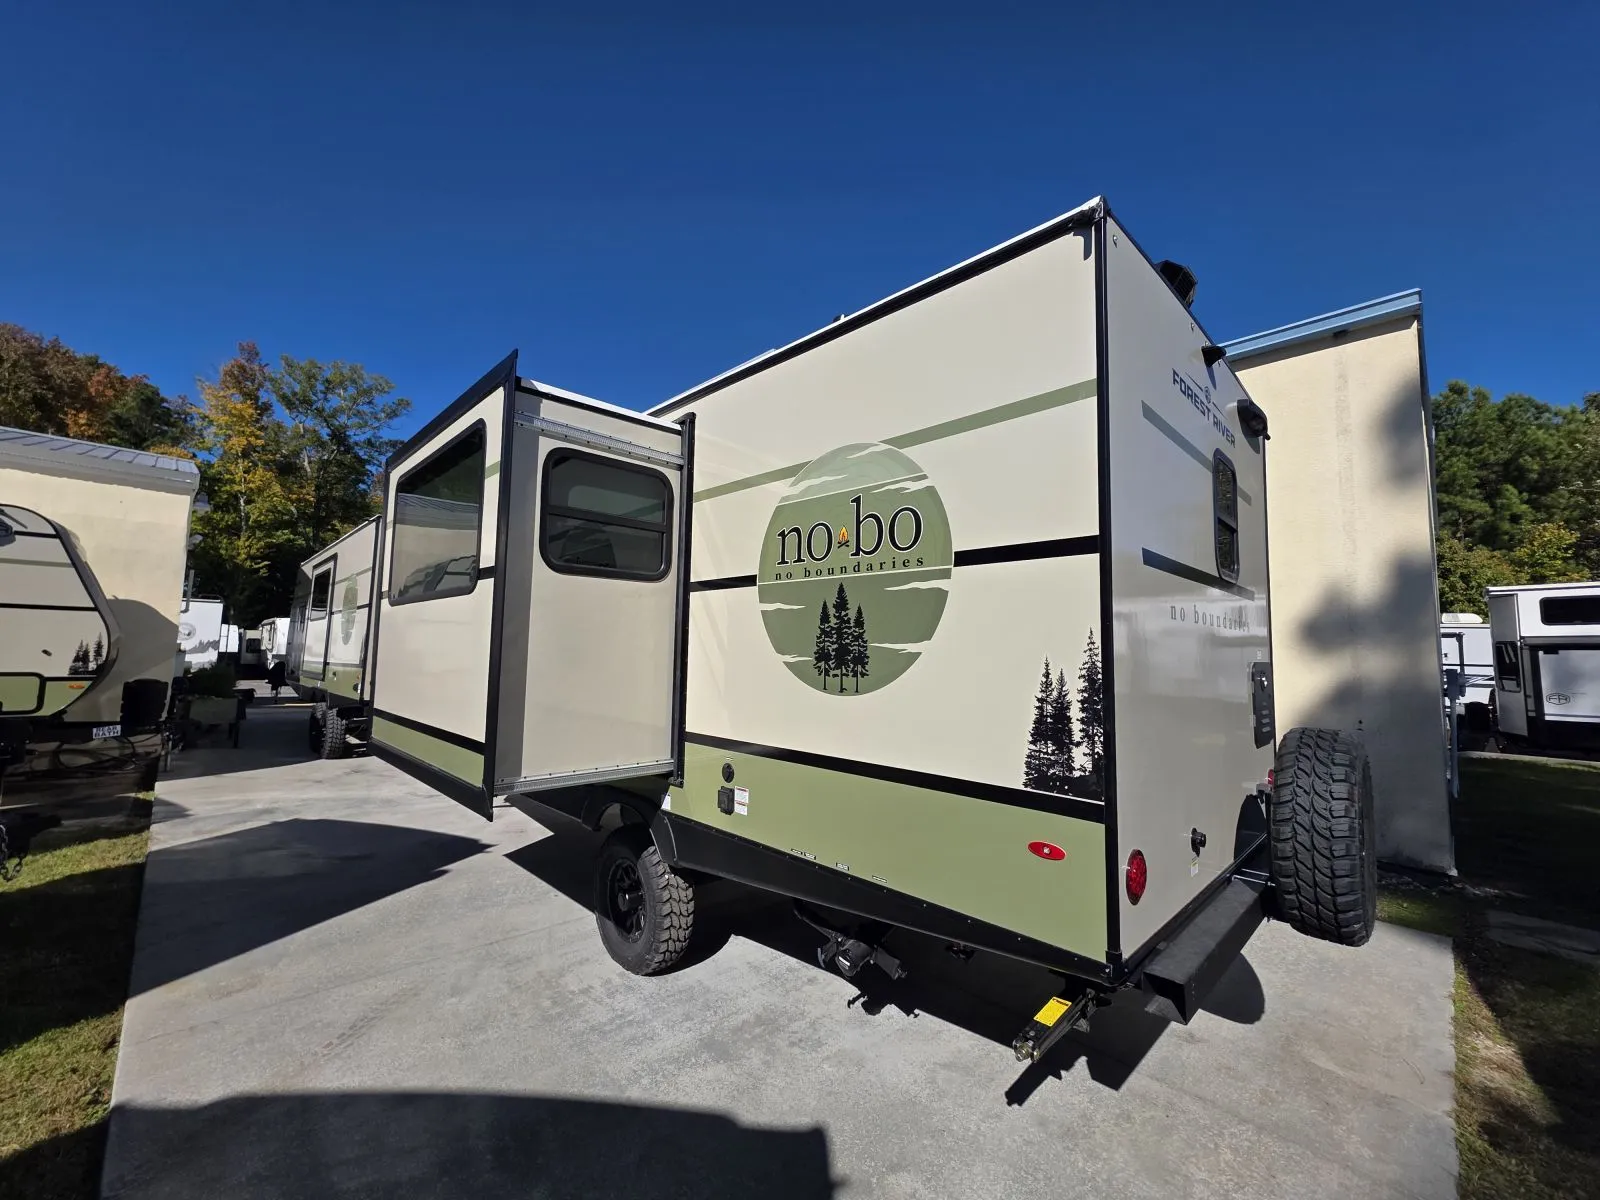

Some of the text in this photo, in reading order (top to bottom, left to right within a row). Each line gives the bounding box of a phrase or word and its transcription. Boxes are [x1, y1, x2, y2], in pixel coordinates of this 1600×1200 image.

[1172, 368, 1236, 449] FOREST RIVER
[775, 556, 924, 580] no boundaries
[1170, 605, 1186, 622] no
